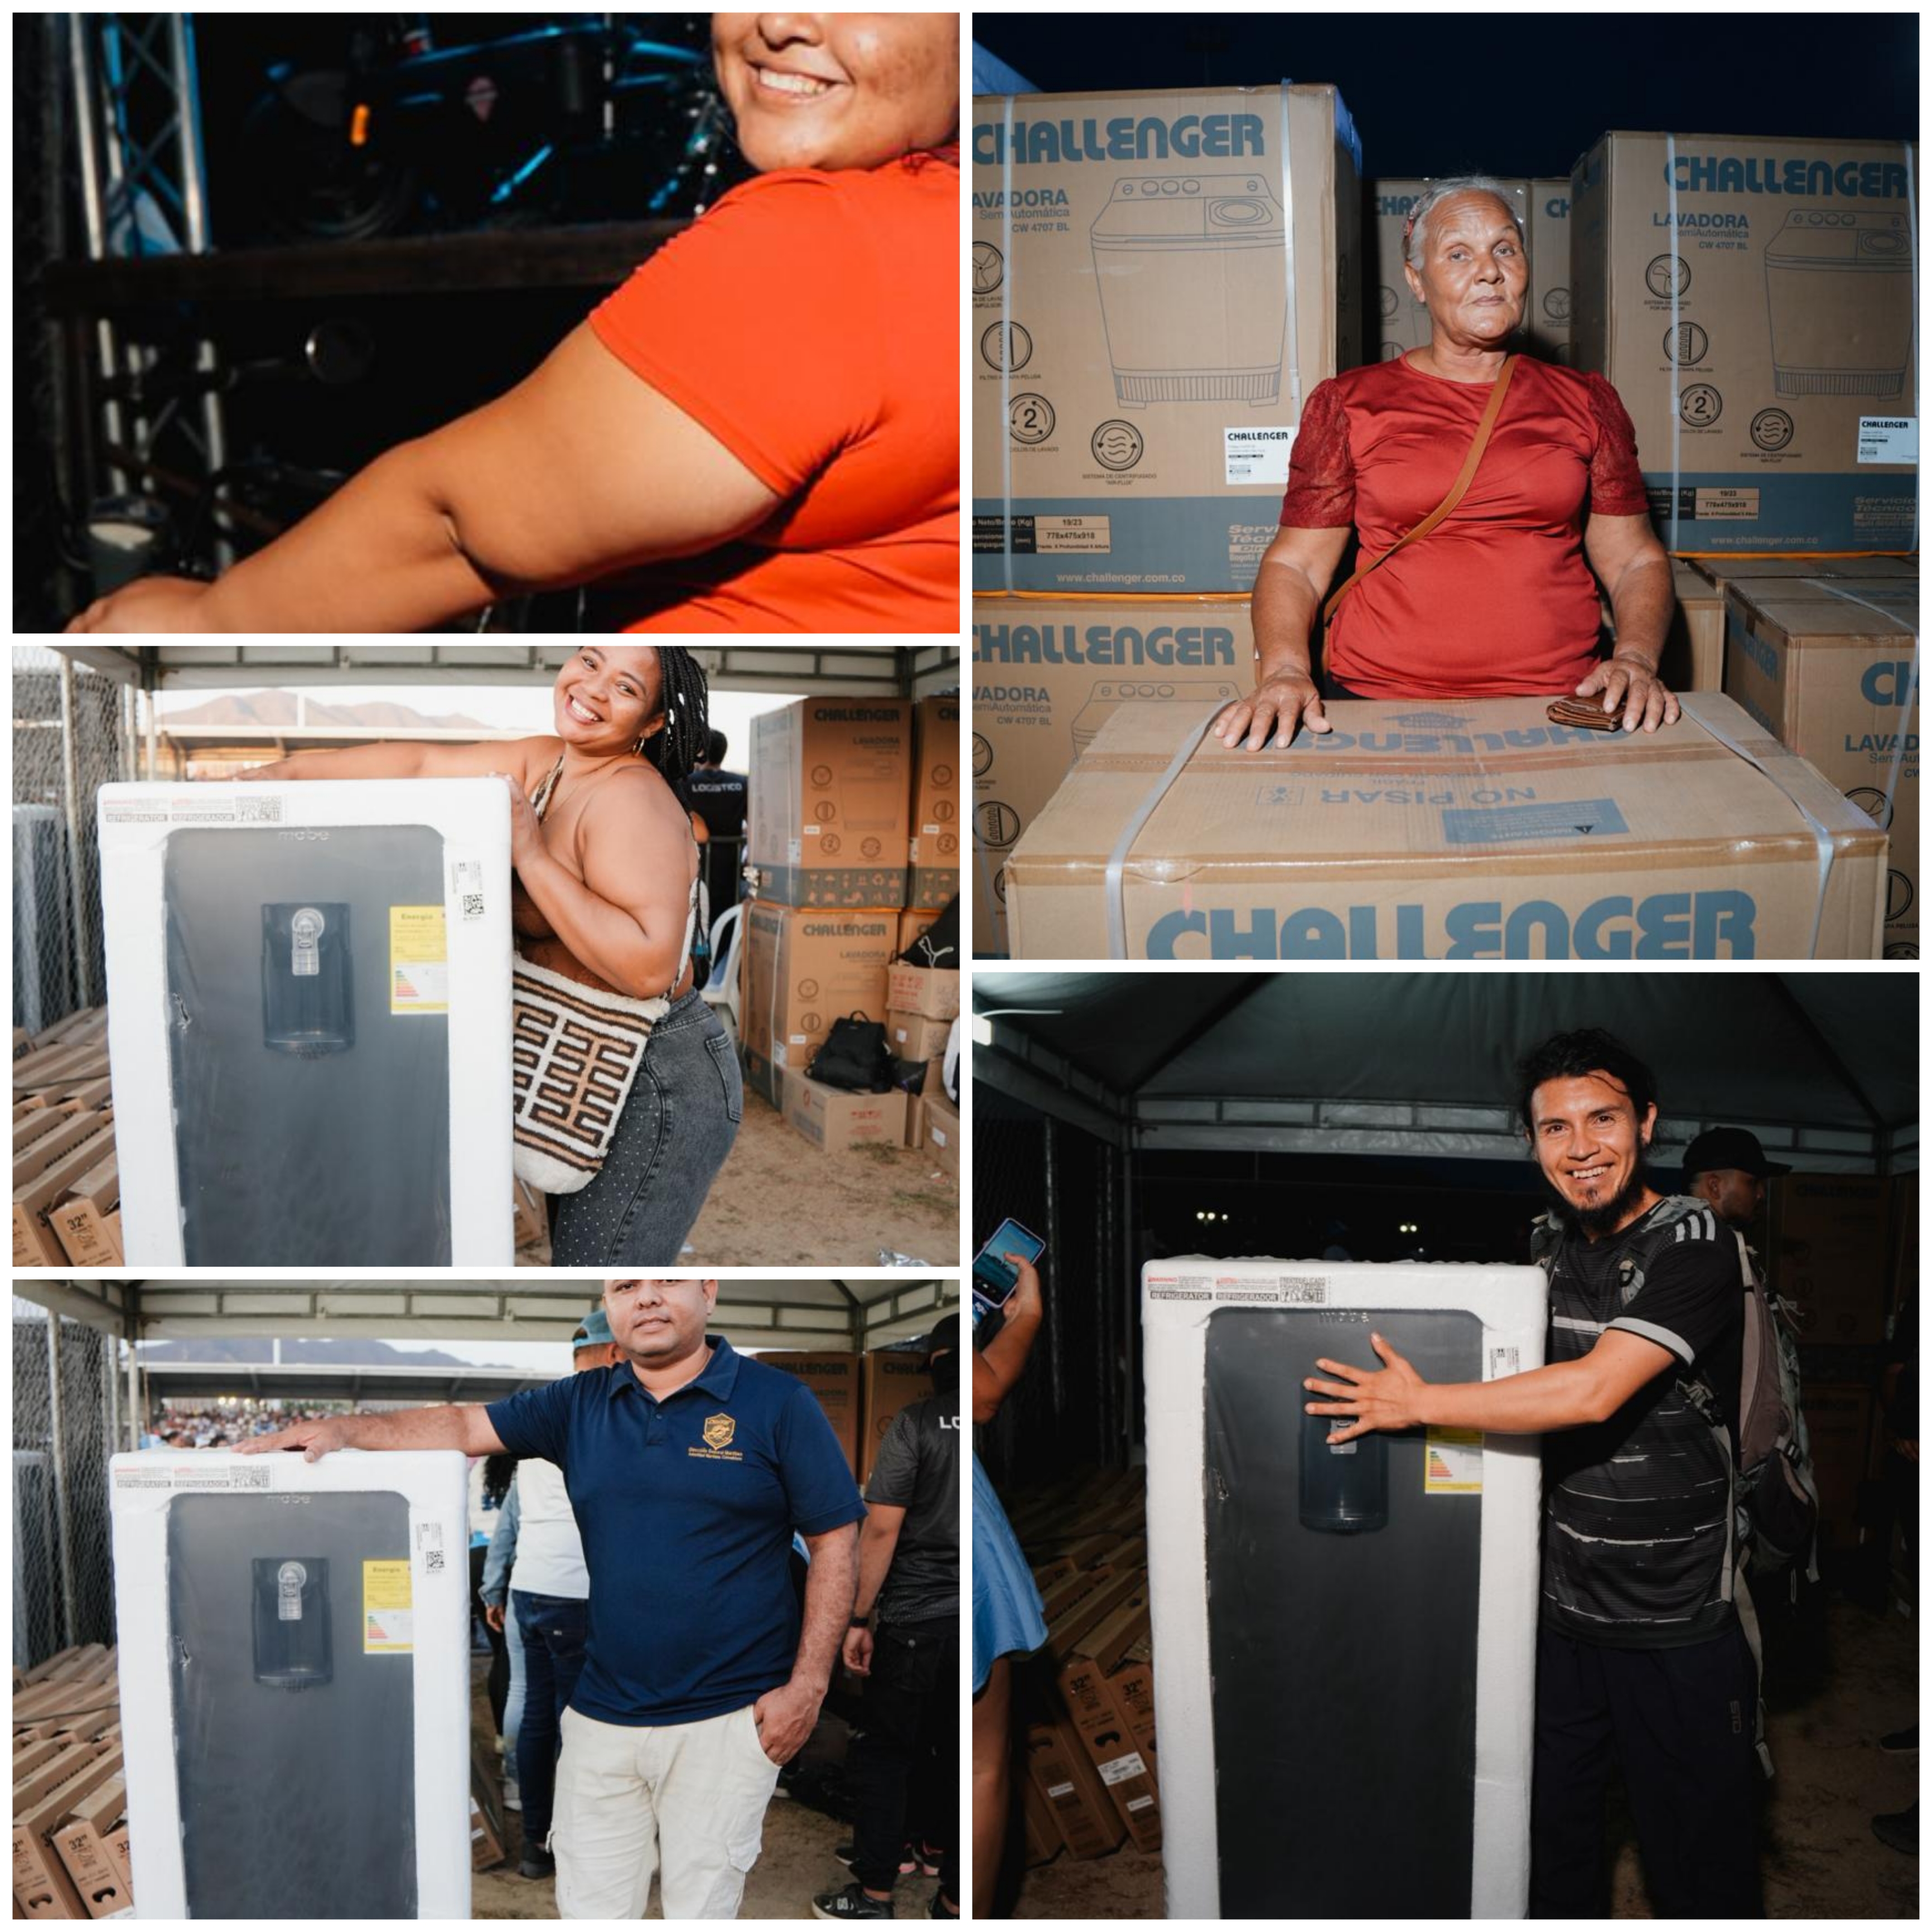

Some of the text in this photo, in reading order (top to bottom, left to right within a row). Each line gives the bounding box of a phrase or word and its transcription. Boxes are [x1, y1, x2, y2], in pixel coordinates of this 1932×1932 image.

[972, 114, 1265, 165] CHALLENGER
[1664, 156, 1908, 198] CHALLENGER
[1653, 212, 1749, 228] LAVADORA
[1012, 222, 1070, 233] CW 4707 BL
[1678, 229, 1749, 239] emiAutomática
[1694, 396, 1706, 414] 2
[1023, 408, 1037, 428] 2
[1228, 432, 1288, 441] CHALLENGER
[1017, 518, 1033, 527] (Kg)
[1046, 532, 1095, 540] 778x475x918
[1711, 536, 1818, 545] www.challenger.com.co
[1056, 572, 1186, 584] www.challenger.com.co
[972, 624, 1235, 665] HALLENGER
[814, 708, 900, 721] CHALLENGER
[997, 716, 1052, 726] CW 4707 BL
[853, 736, 900, 745] LAVADORA
[1320, 787, 1537, 805] NO PISAR
[803, 923, 886, 936] CHALLENGER
[1146, 890, 1757, 960] CHALLENGER
[839, 950, 886, 959] LAVADORA
[1217, 1293, 1277, 1301] REFRIGERADOR
[69, 1834, 88, 1850] 32"
